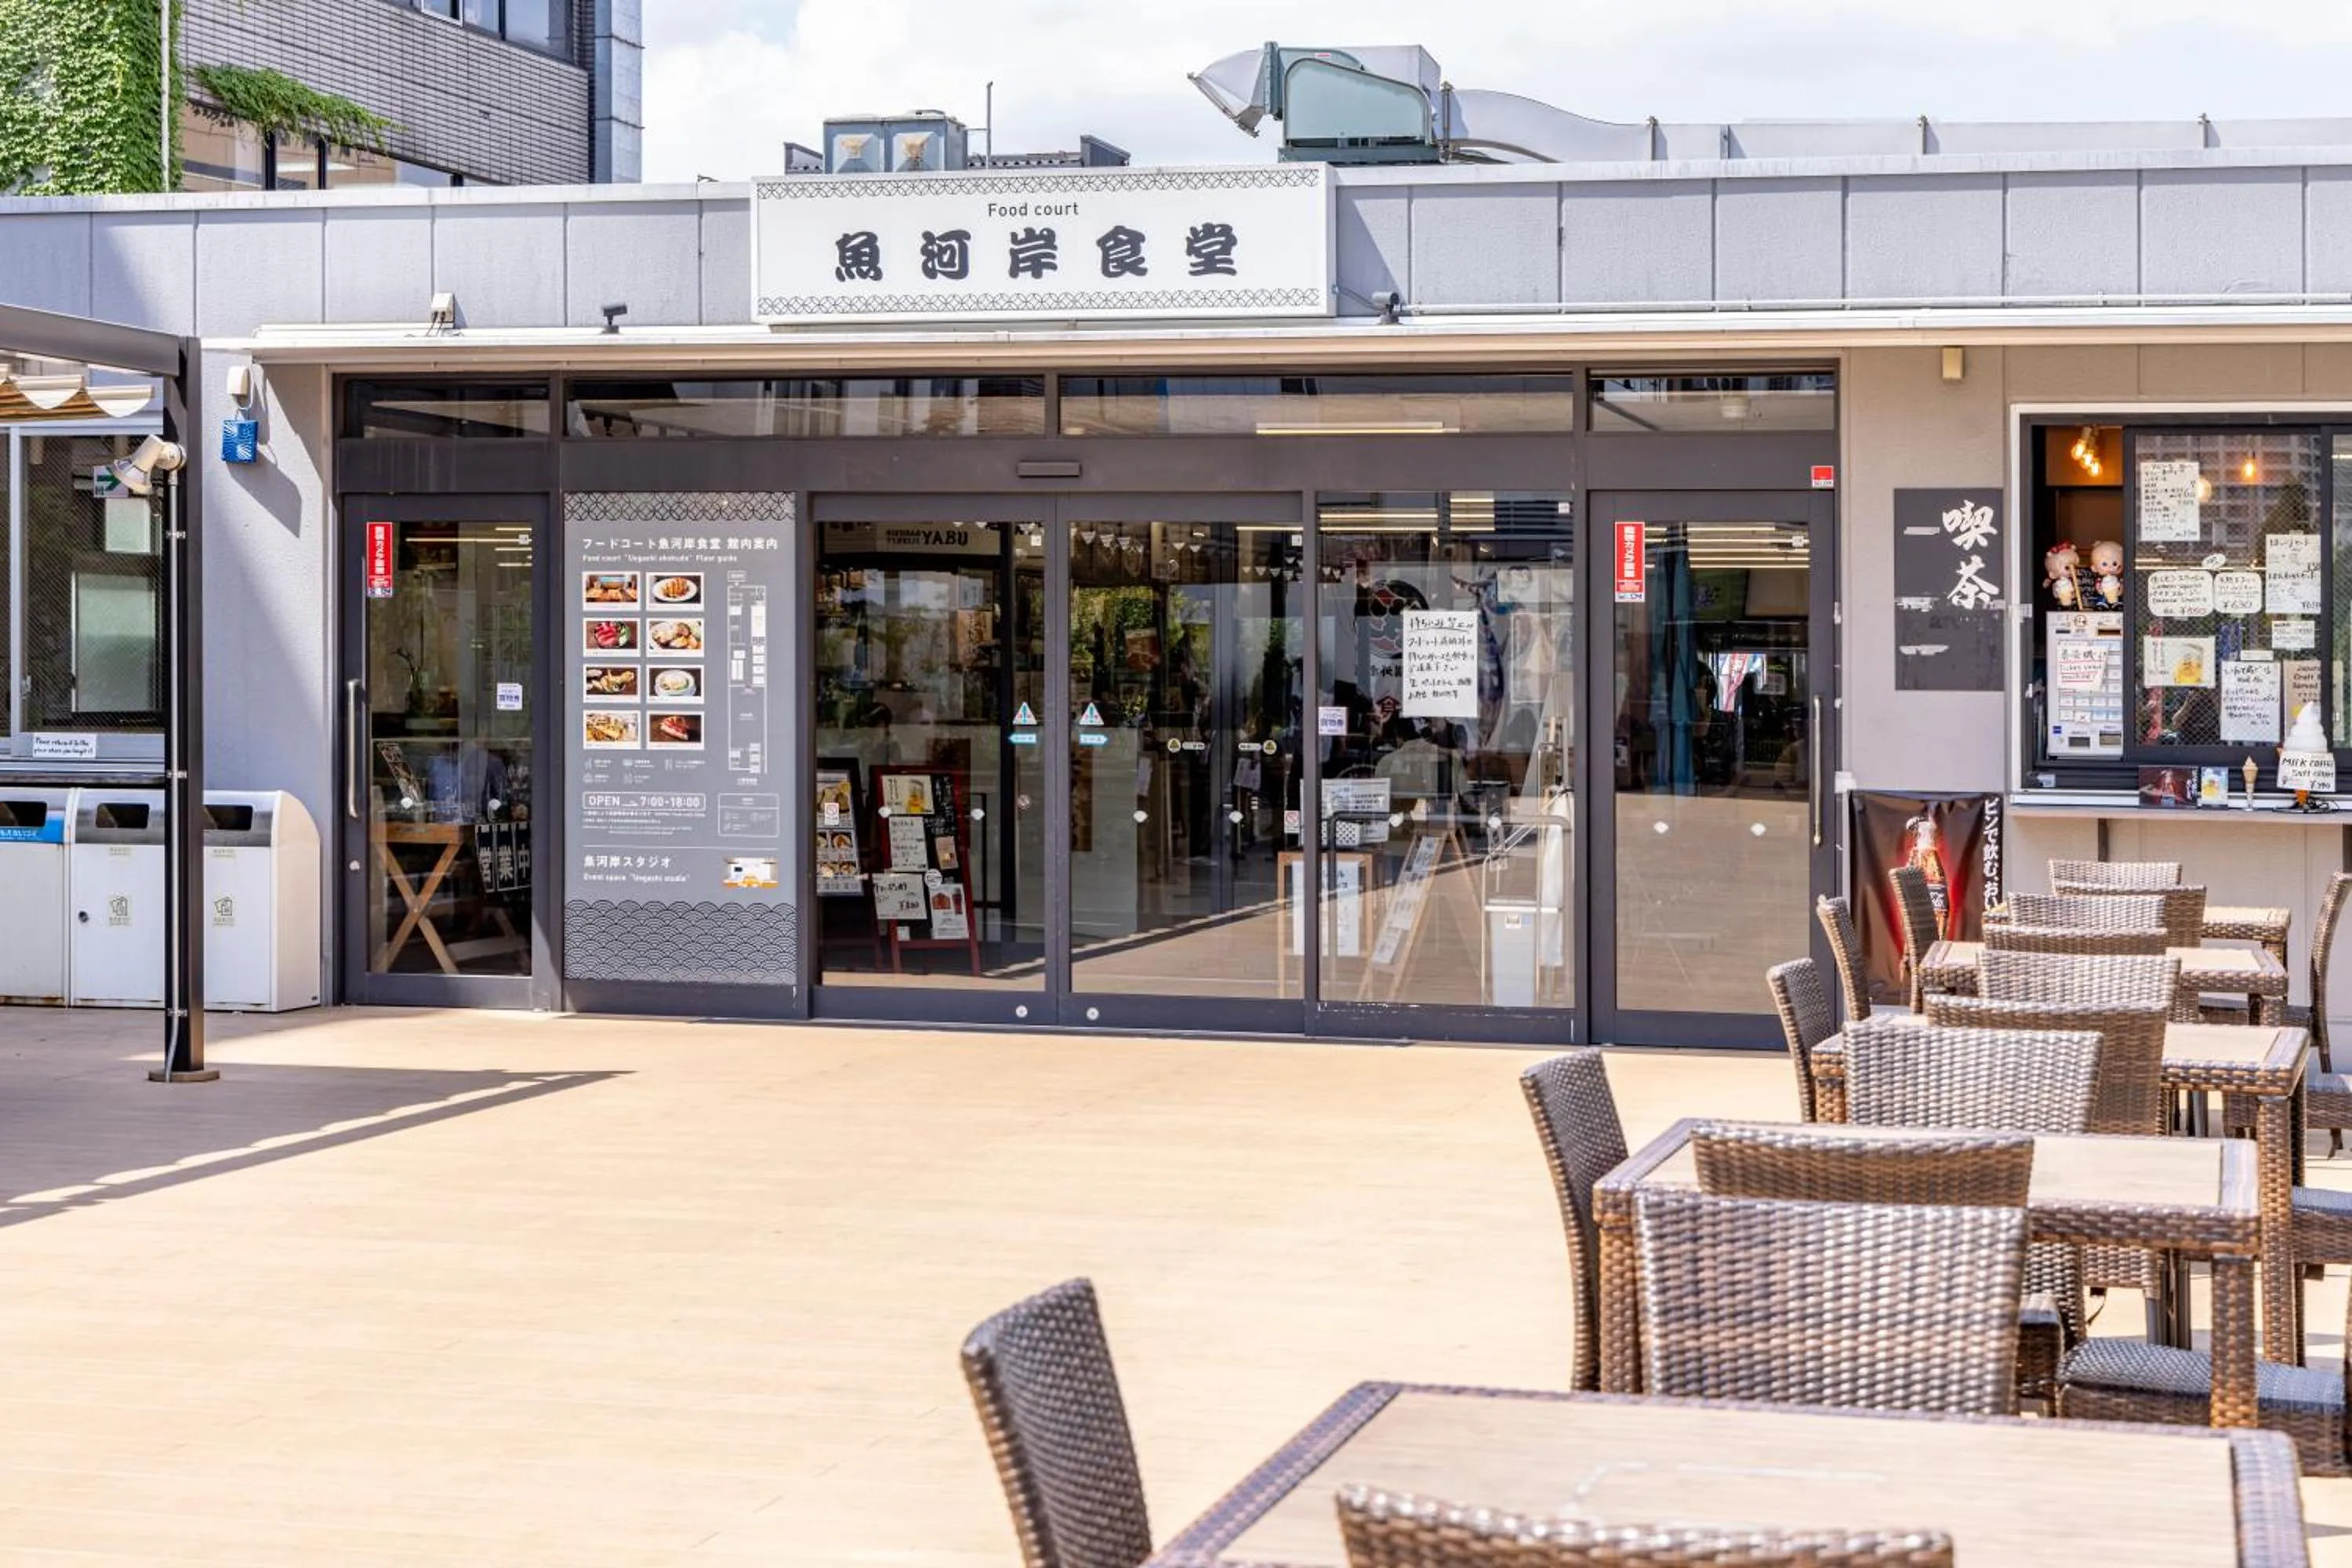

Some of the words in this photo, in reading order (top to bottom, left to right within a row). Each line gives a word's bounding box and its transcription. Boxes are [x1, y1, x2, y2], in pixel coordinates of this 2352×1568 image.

[988, 201, 1029, 217] Food
[1034, 201, 1080, 216] court
[834, 221, 1239, 283] 魚河岸食堂
[921, 530, 968, 546] YABU
[1942, 499, 2000, 610] 喫茶
[589, 795, 620, 806] OPEN
[639, 795, 700, 808] 7:00-18:00
[479, 842, 530, 883] 営業中
[584, 855, 670, 868] 魚河岸スタジオ
